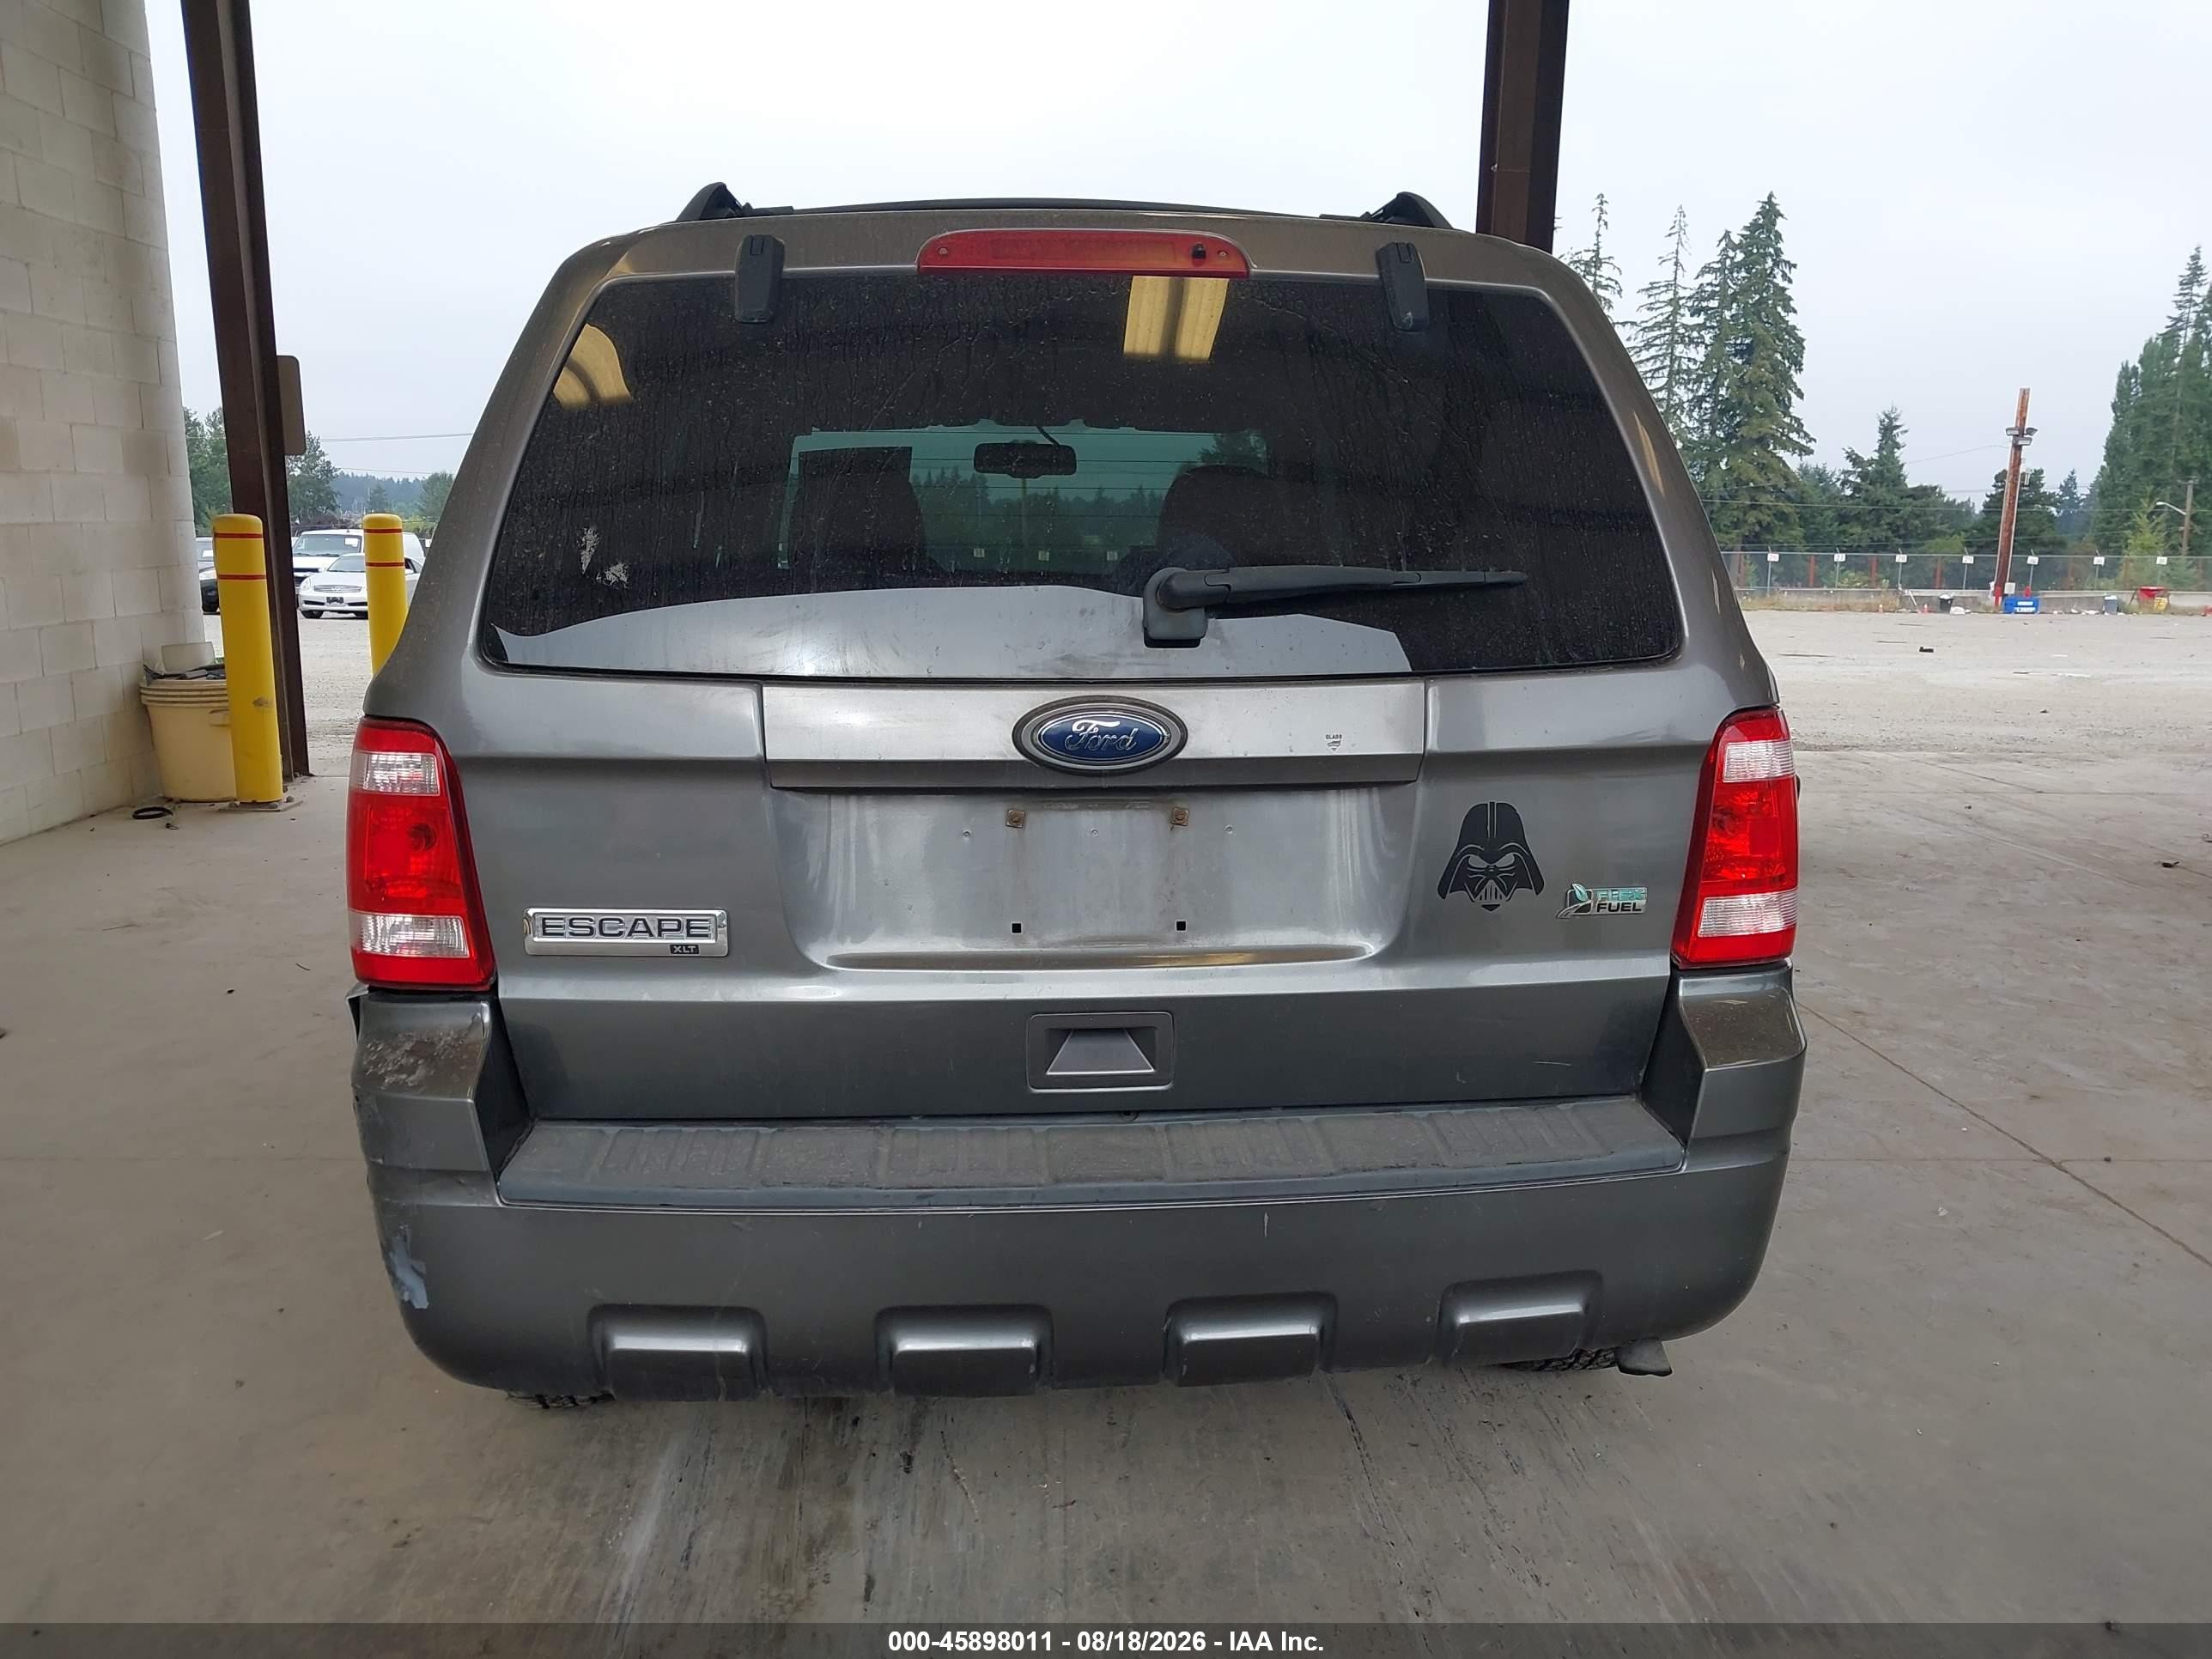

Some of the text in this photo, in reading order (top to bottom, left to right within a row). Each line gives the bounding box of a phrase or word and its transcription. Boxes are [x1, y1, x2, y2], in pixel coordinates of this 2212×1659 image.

[1064, 719, 1139, 750] Ford
[1596, 902, 1642, 913] FUEL
[541, 916, 711, 939] ESCAPE
[672, 945, 697, 954] XLT
